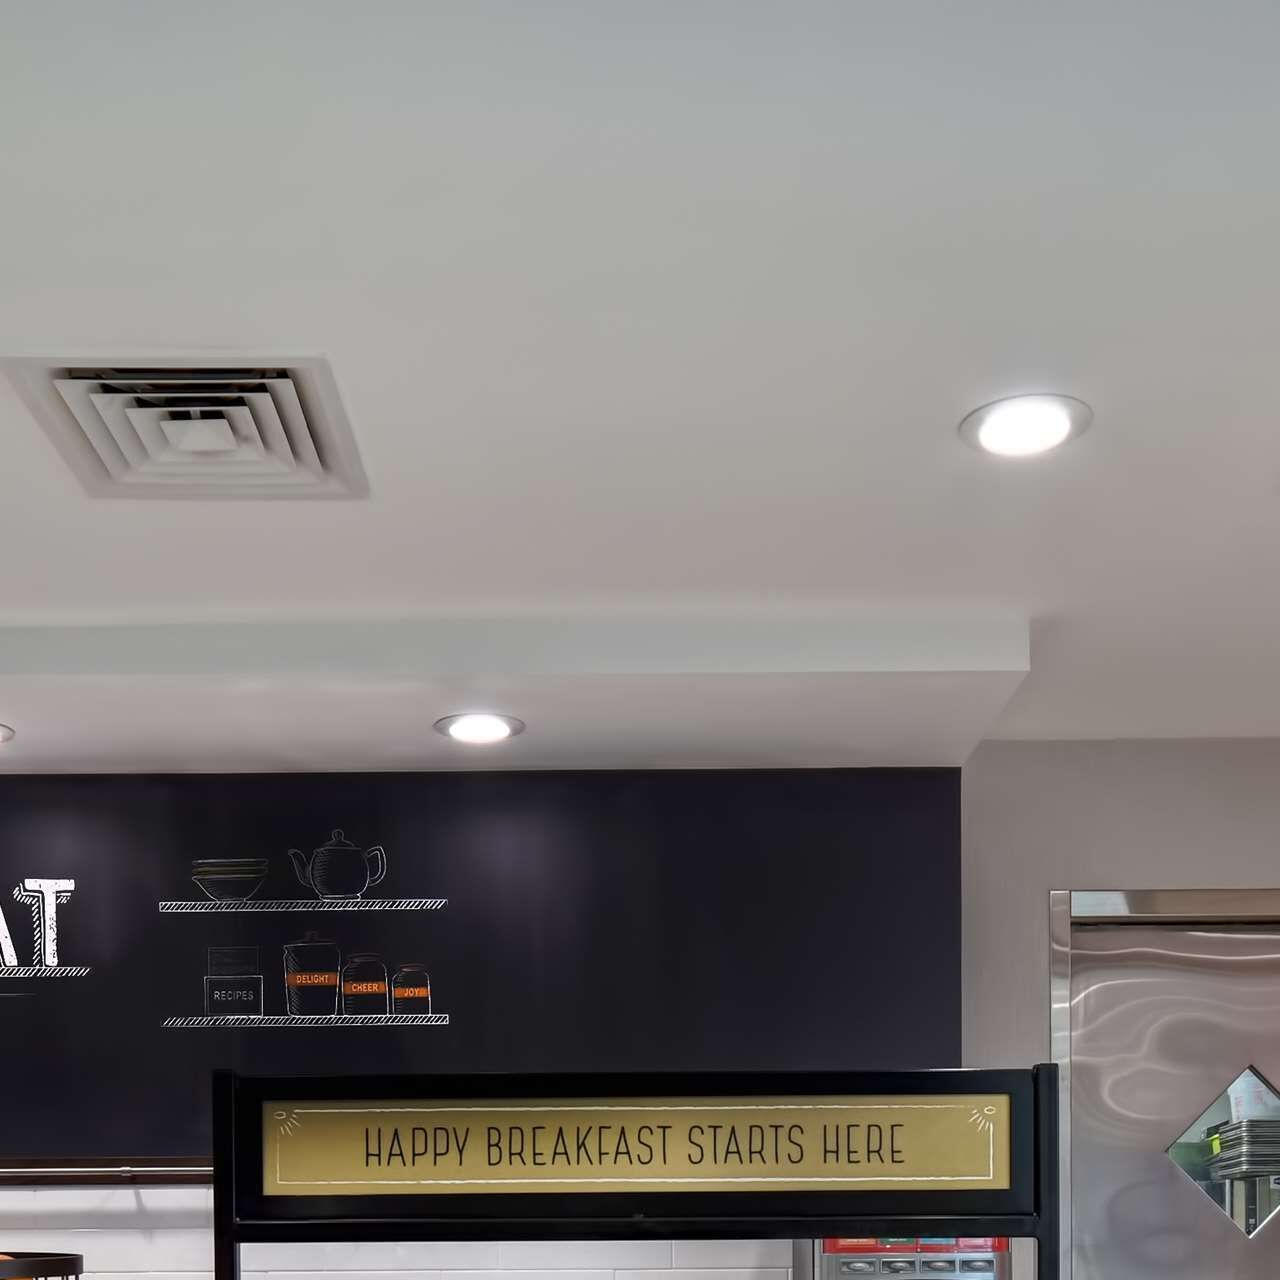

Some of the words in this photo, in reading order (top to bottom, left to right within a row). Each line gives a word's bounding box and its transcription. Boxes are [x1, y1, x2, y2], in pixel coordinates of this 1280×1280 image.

[296, 974, 329, 984] DELIGHT
[351, 983, 378, 993] CHEER
[404, 988, 420, 997] JOY
[213, 990, 254, 1001] RECIPES
[365, 1126, 470, 1167] HAPPY
[486, 1125, 672, 1166] BREAKFAST
[687, 1124, 805, 1165] STARTS
[823, 1124, 905, 1165] HERE
